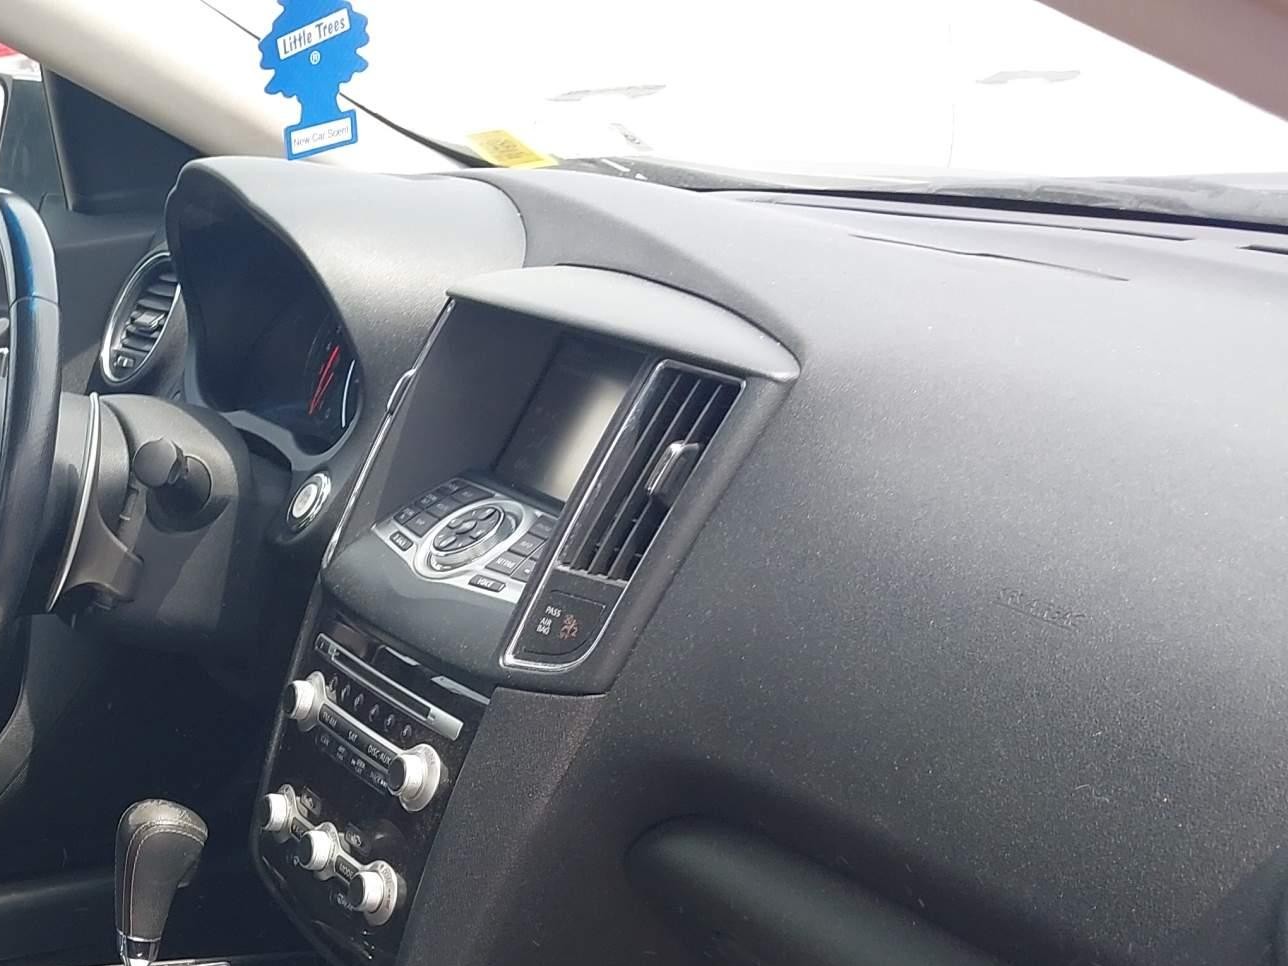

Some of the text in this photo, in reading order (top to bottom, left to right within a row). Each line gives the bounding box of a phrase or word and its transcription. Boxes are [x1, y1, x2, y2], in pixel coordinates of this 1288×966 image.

[283, 17, 346, 55] Little Trees
[545, 605, 562, 618] PASS
[539, 617, 552, 627] AIR
[536, 624, 551, 636] BAG
